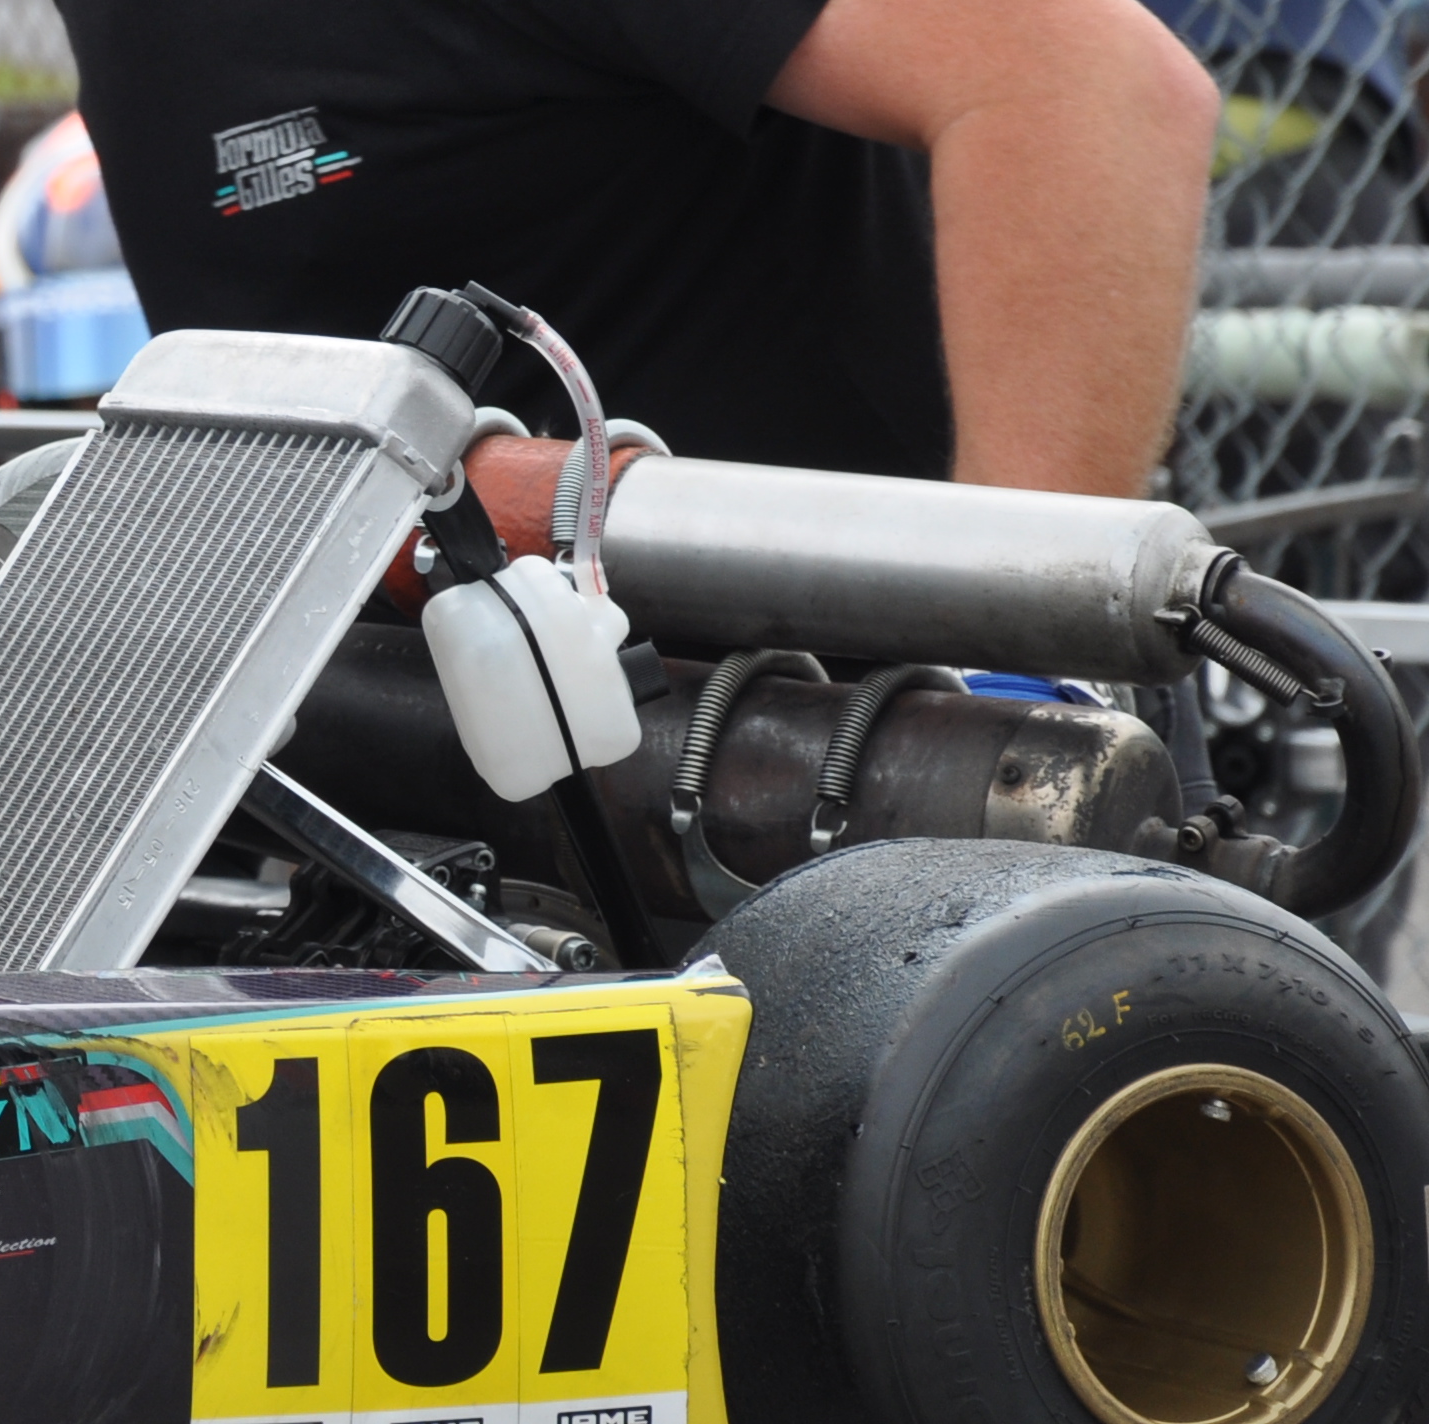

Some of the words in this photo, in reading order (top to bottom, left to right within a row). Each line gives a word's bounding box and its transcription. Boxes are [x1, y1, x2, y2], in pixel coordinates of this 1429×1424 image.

[585, 417, 606, 481] ACCESSORI
[590, 487, 604, 508] PER
[235, 1027, 663, 1390] 167
